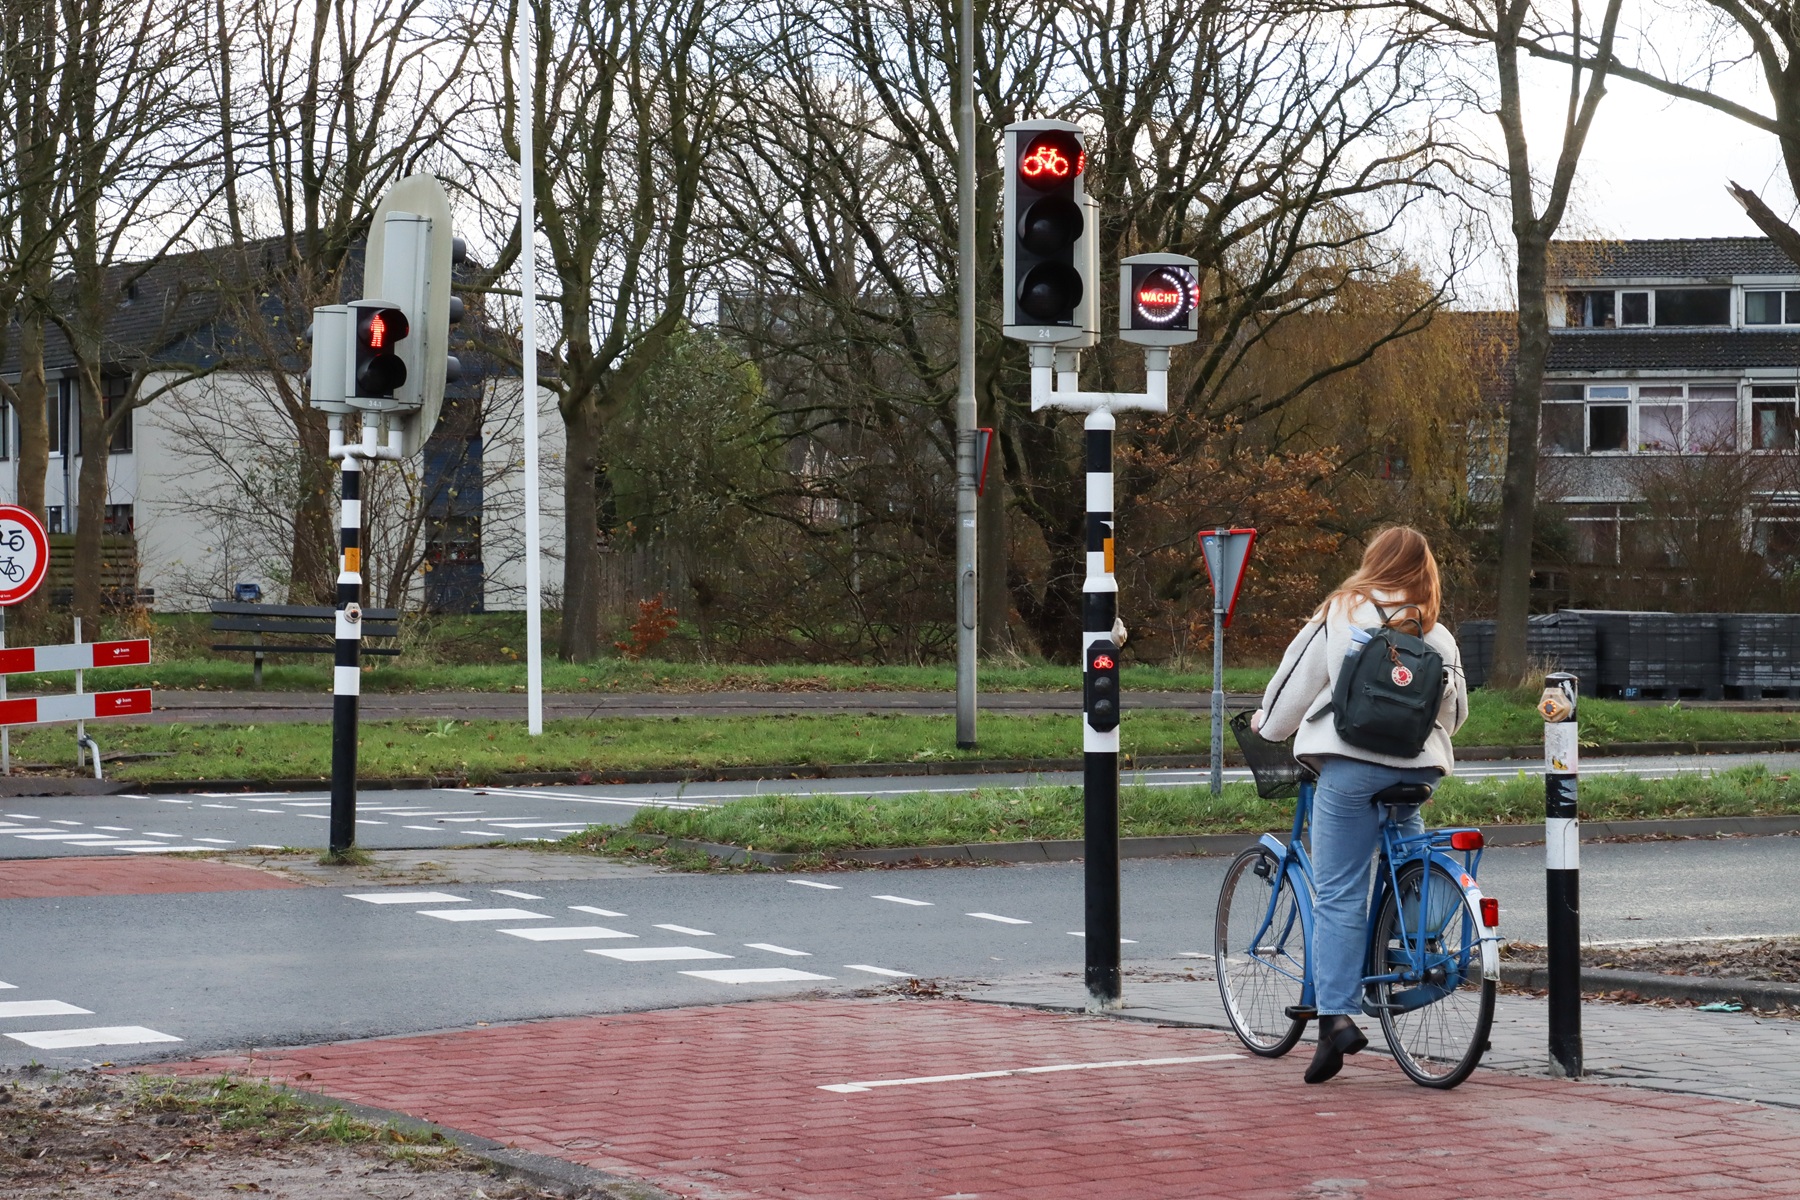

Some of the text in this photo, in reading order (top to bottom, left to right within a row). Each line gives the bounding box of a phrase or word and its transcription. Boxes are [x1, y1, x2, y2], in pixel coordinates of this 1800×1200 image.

[1140, 292, 1178, 303] WACHT
[1151, 308, 1168, 316] BUS
[1038, 329, 1050, 338] 24
